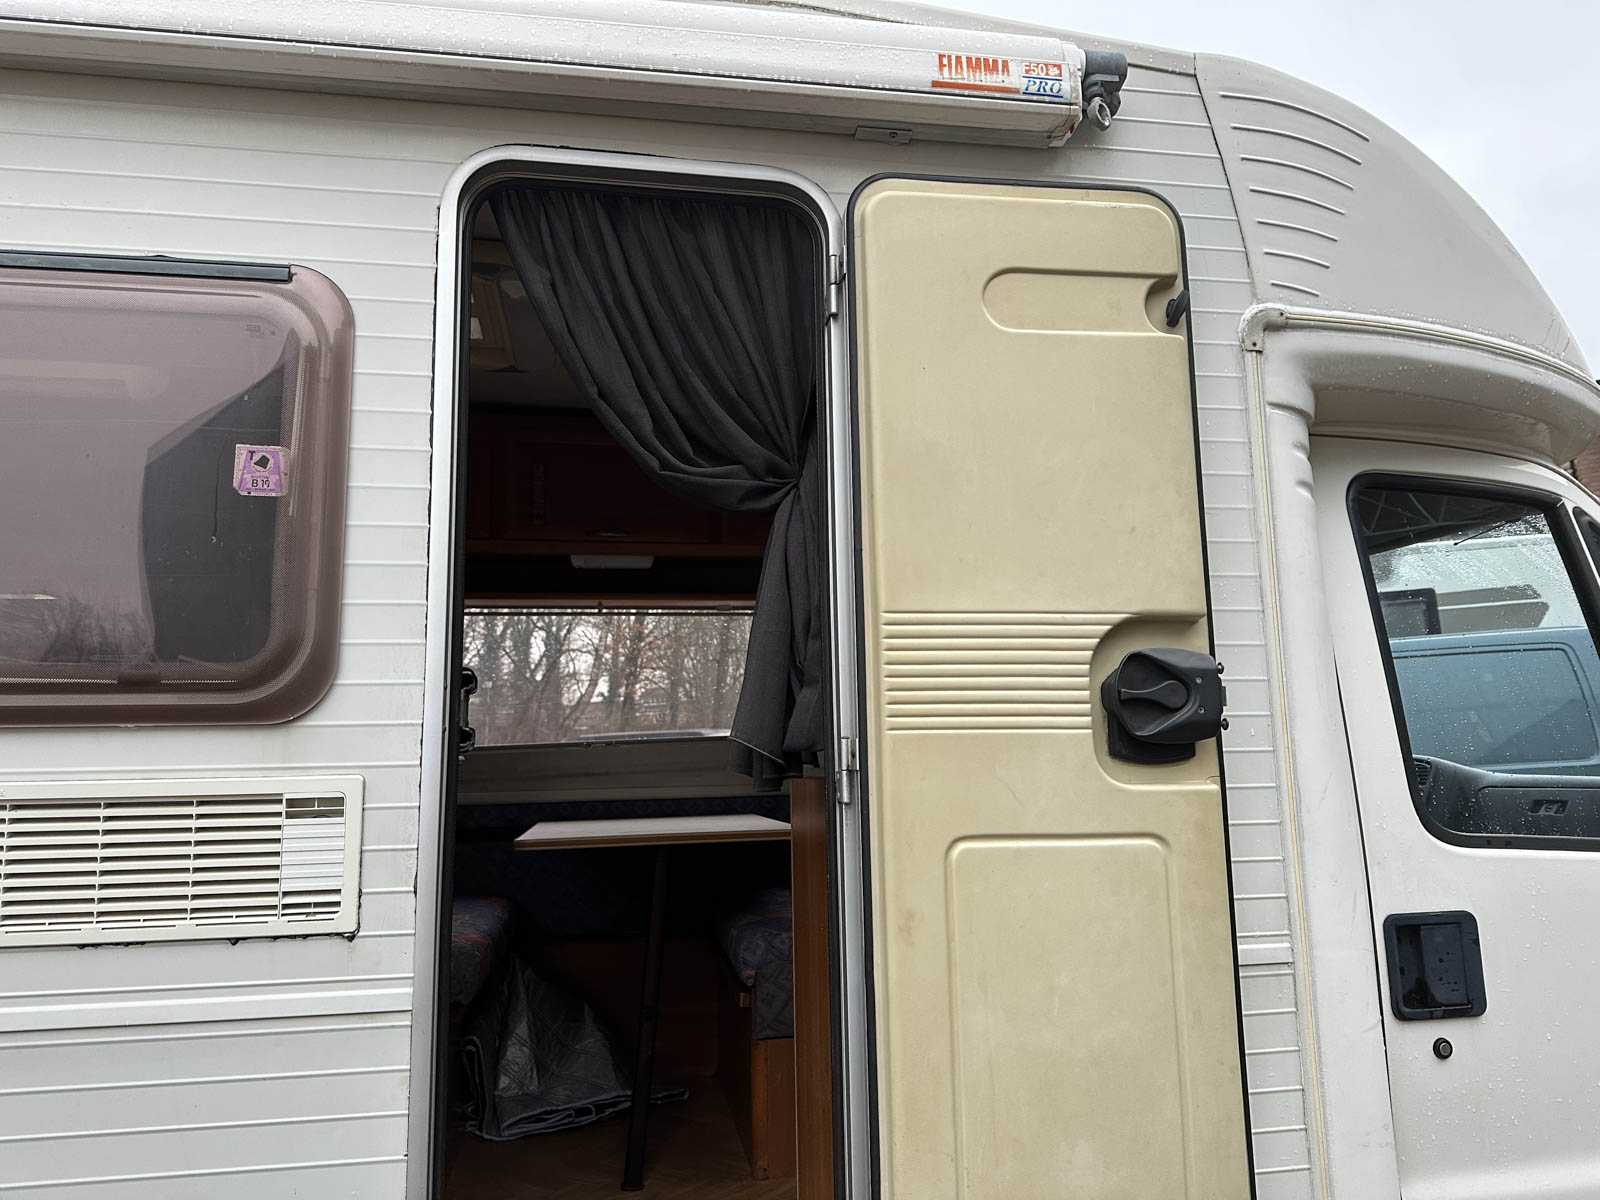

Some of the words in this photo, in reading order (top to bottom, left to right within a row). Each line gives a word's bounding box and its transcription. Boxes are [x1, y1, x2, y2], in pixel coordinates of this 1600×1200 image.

[938, 54, 1010, 77] FIAMMA
[1022, 62, 1047, 76] F50
[1024, 79, 1063, 94] PRO
[248, 450, 256, 461] T
